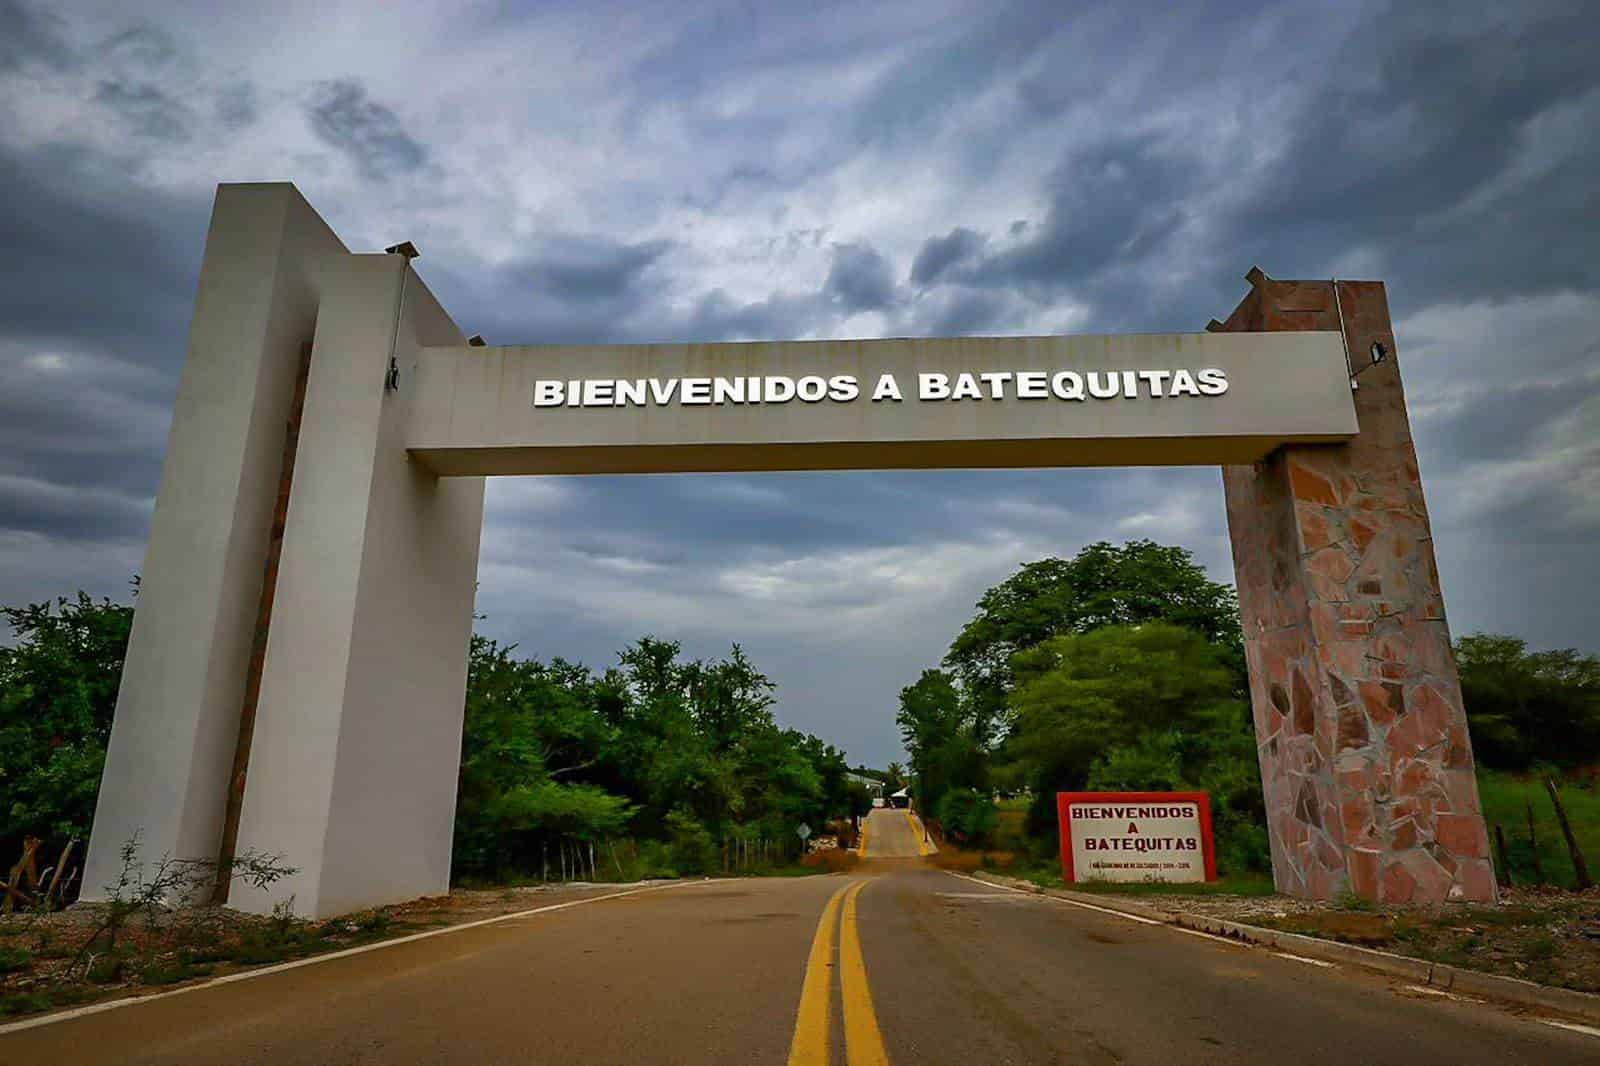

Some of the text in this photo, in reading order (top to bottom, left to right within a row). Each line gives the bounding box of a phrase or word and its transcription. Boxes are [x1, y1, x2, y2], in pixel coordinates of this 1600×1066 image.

[533, 368, 1229, 407] BIENVENIDOS A BATEQUITAS
[1071, 807, 1195, 819] BIENVENIDOS
[1127, 822, 1139, 834] A
[1084, 838, 1197, 853] BATEQUITAS
